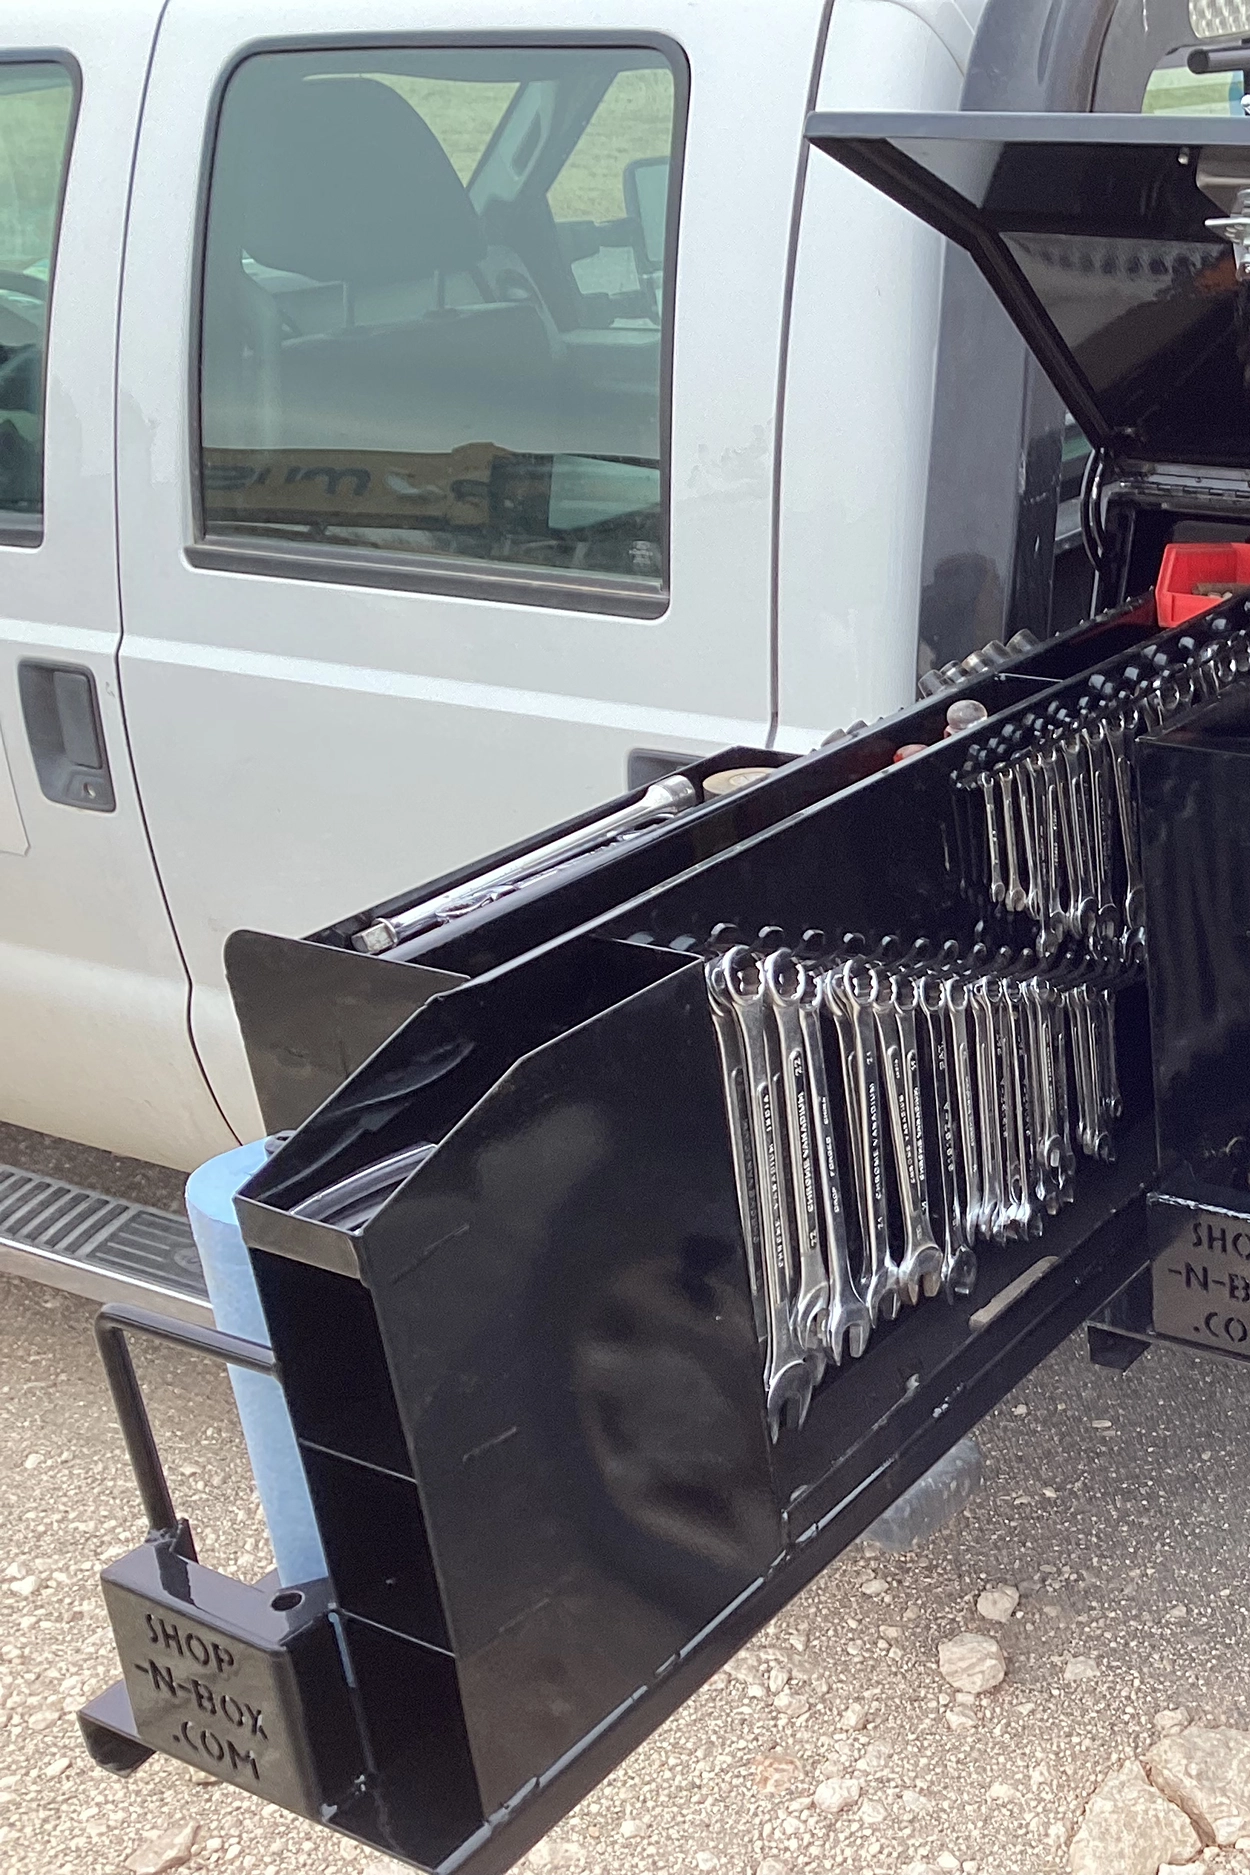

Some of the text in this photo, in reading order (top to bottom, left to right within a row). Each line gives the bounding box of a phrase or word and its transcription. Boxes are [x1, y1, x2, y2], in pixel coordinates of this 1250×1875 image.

[794, 1057, 803, 1076] 22
[797, 1091, 809, 1159] VANADIUM
[869, 1083, 879, 1146] VANADIUM
[825, 1136, 835, 1177] FORGED
[873, 1150, 882, 1200] CHROME
[803, 1158, 814, 1213] CHROME
[831, 1186, 840, 1213] DROP
[146, 1613, 234, 1672] SHOP
[134, 1658, 269, 1740] -N-BOX
[172, 1720, 260, 1780] .COM
